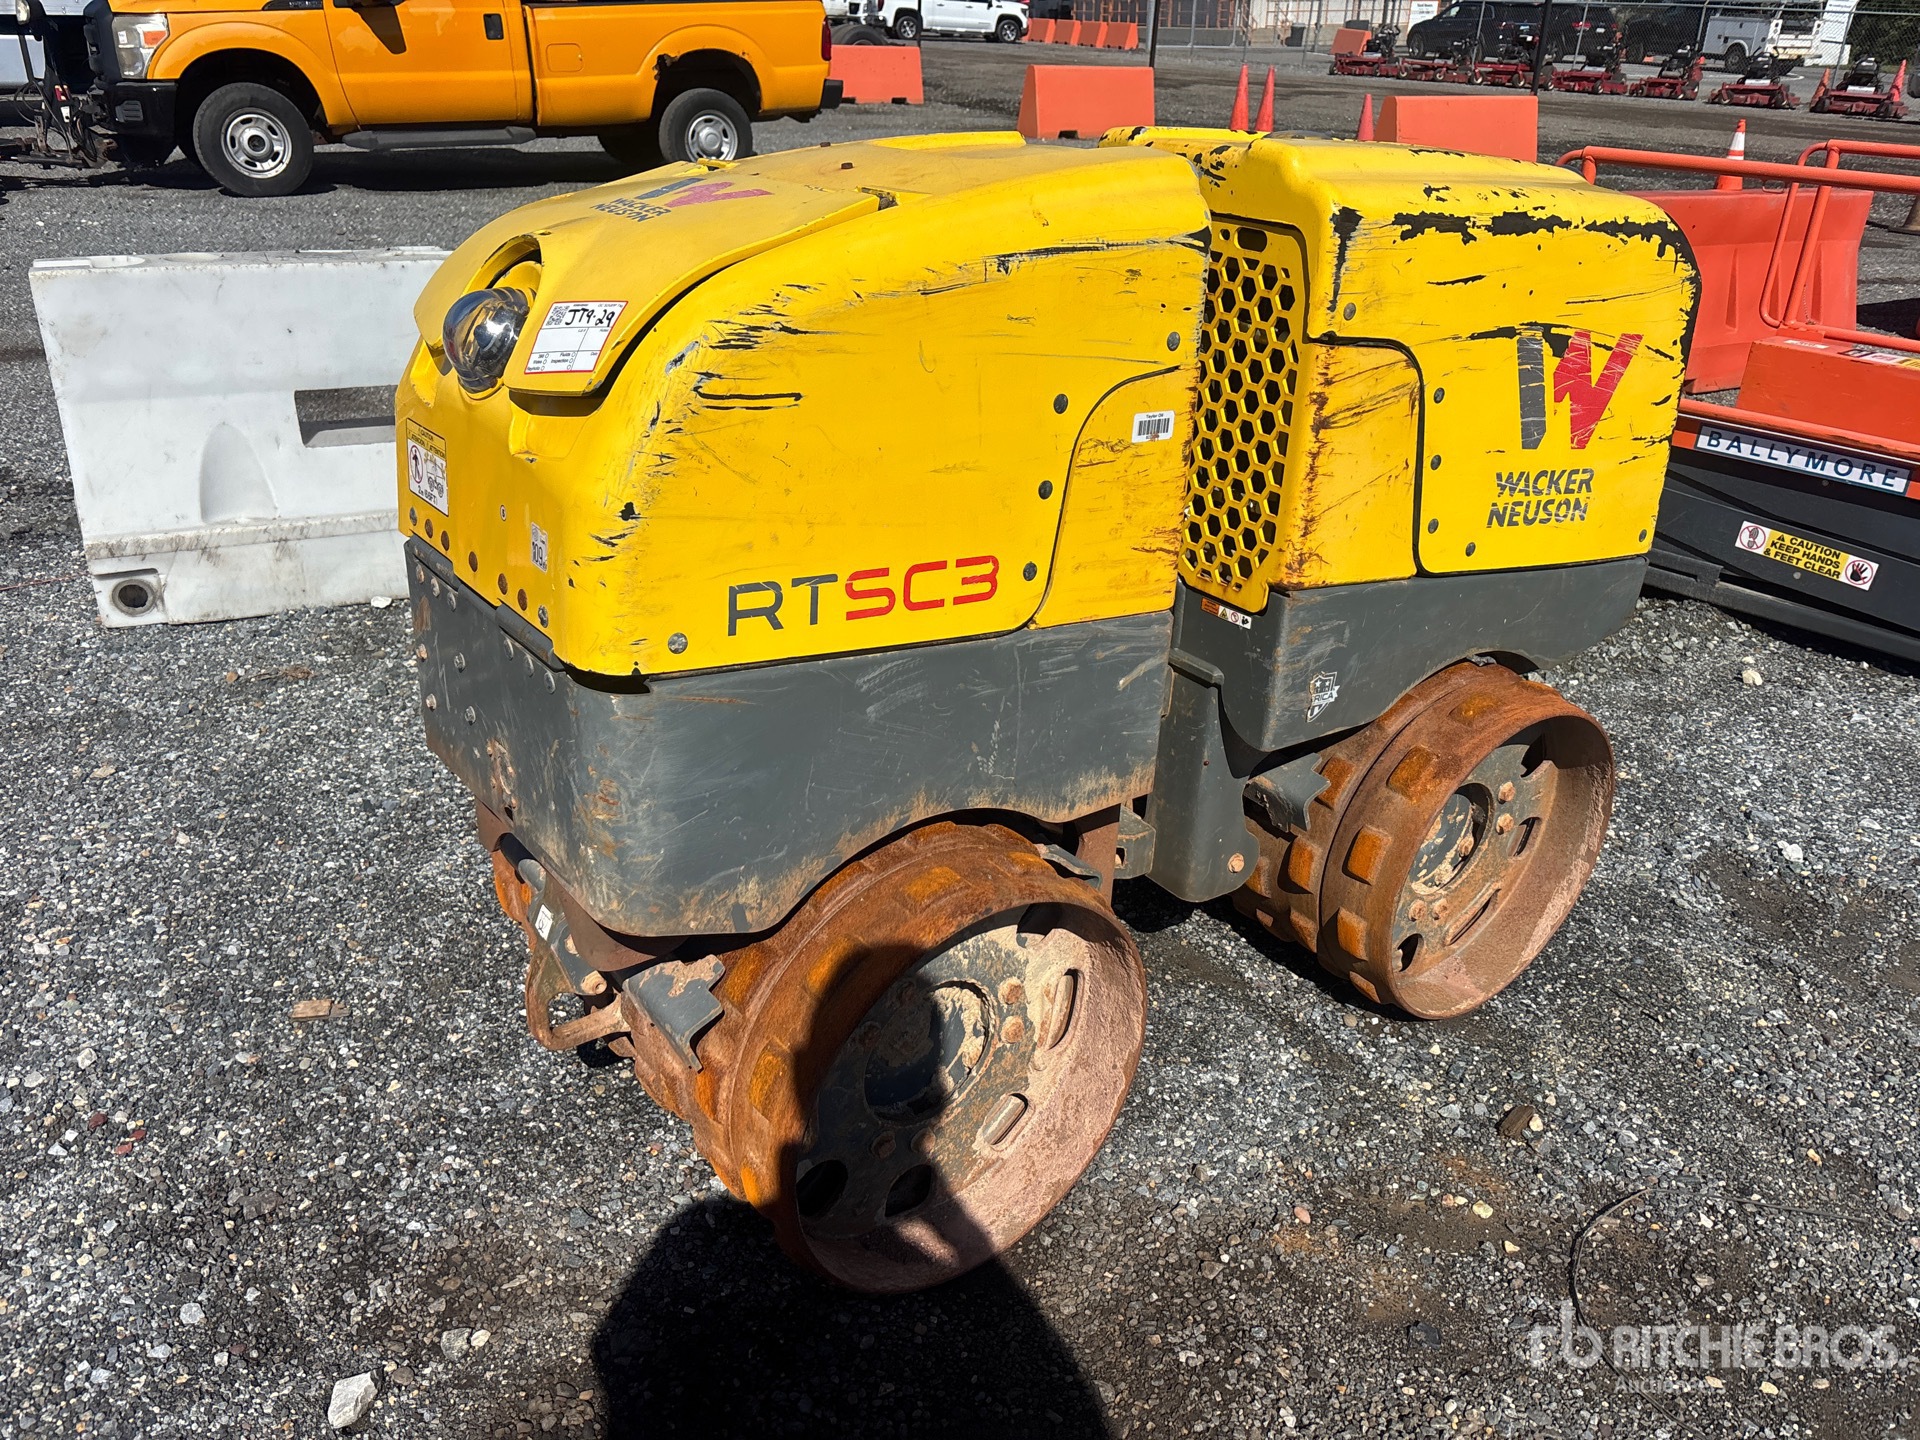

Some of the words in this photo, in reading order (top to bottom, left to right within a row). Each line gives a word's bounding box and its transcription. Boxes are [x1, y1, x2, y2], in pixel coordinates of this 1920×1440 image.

[590, 203, 655, 222] NEUSON
[613, 197, 672, 217] WACKER
[1707, 430, 1898, 488] BALLYMORE
[1496, 468, 1595, 498] WACKER
[1486, 497, 1589, 528] NEUSON
[1770, 540, 1801, 555] KEEP
[1801, 550, 1841, 570] HANDS
[1789, 537, 1841, 560] CAUTION
[1763, 548, 1772, 557] &
[1773, 550, 1801, 566] FEET
[1803, 561, 1841, 580] CLEAR
[728, 554, 999, 636] RTSC3
